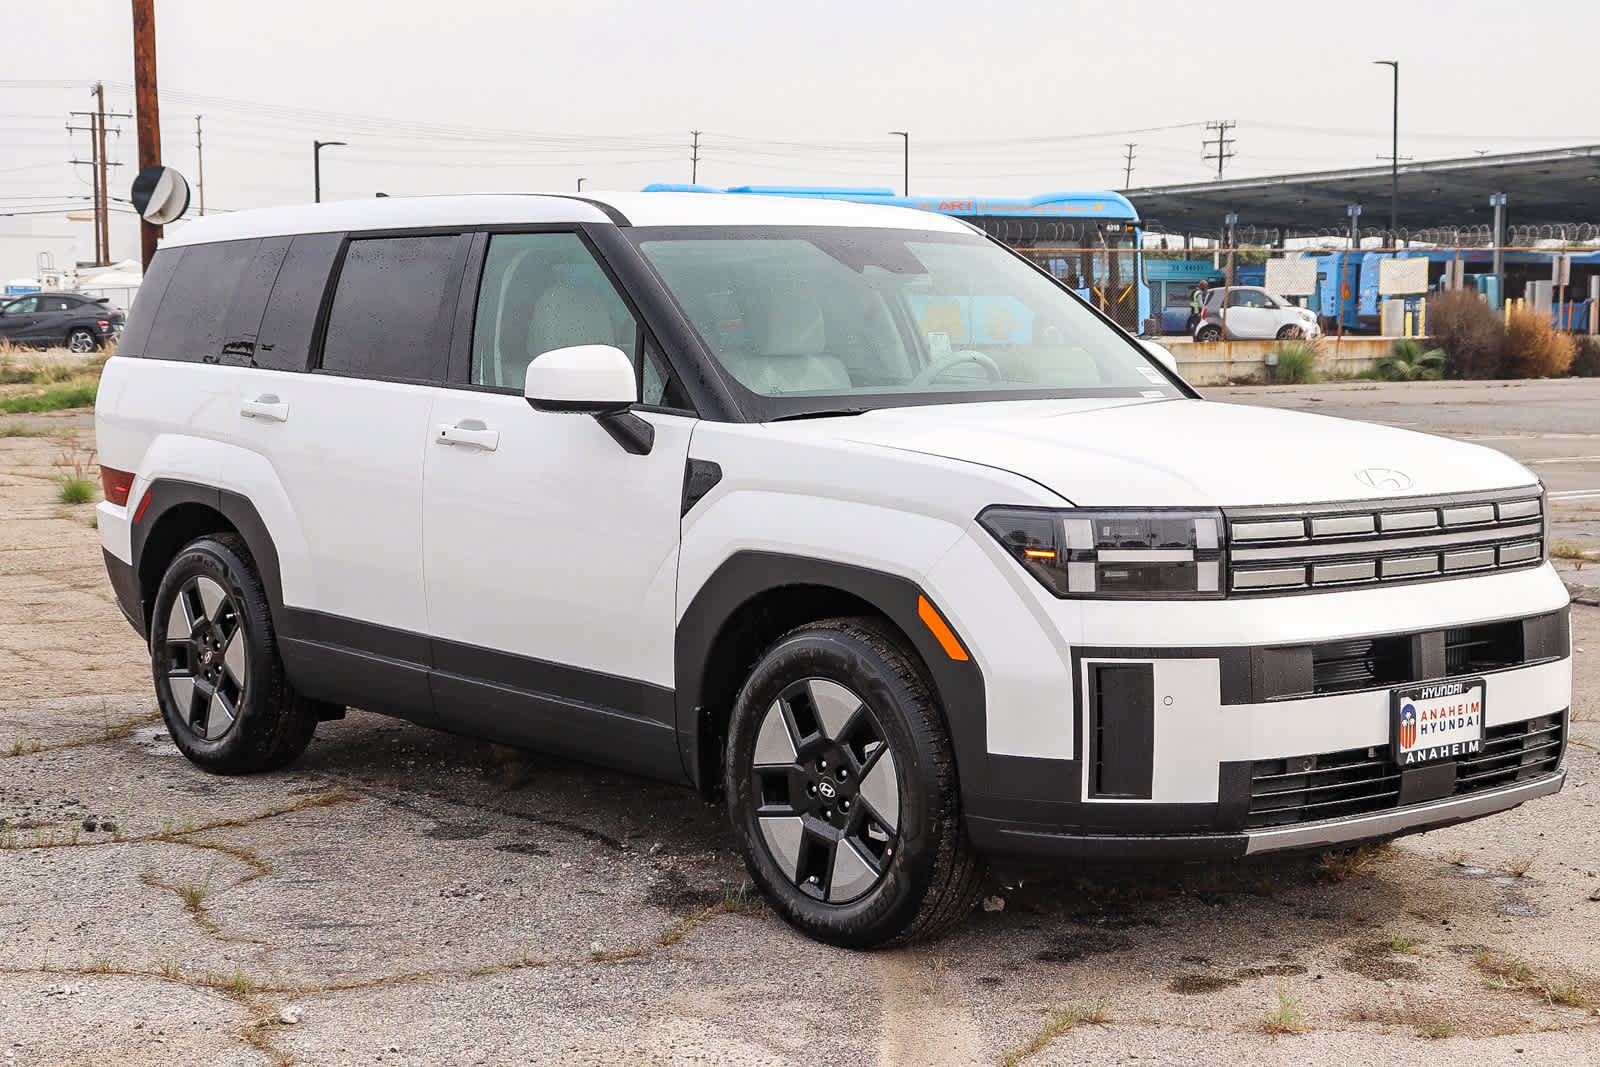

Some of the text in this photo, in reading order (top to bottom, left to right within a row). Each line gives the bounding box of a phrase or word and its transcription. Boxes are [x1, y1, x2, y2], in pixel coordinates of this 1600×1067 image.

[937, 200, 974, 211] ART
[1421, 684, 1462, 698] HYUNDAI
[1421, 702, 1479, 721] ANAHEIM
[1421, 715, 1478, 734] HYUNDAI
[1406, 741, 1479, 763] ANAHEIM
